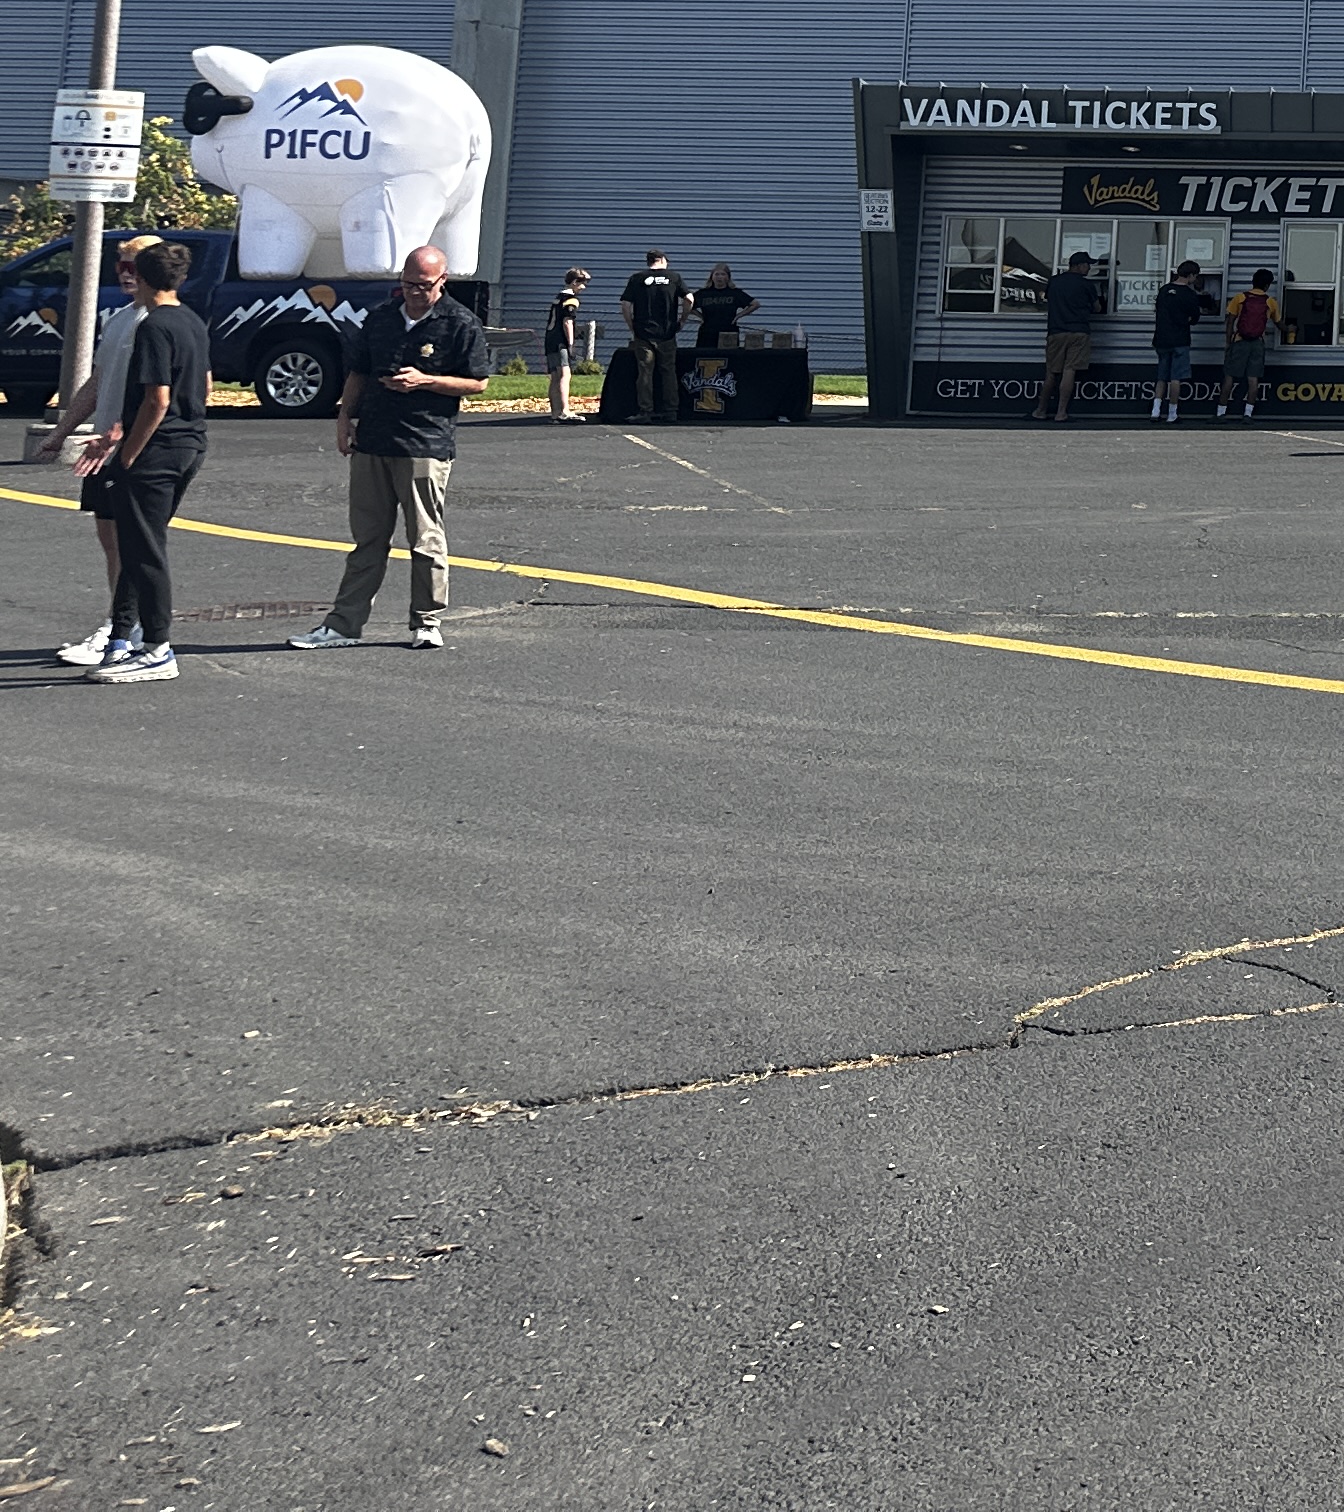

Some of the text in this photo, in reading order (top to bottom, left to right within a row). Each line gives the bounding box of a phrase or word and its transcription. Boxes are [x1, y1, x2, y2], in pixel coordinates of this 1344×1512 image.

[903, 98, 1218, 131] VANDAL TICKETS
[264, 128, 371, 161] P1FCU
[1083, 172, 1160, 212] Vandals
[1121, 280, 1163, 292] TICKET
[1123, 294, 1158, 306] SALES
[681, 371, 738, 398] Vandals
[936, 378, 985, 399] GET
[988, 379, 1055, 399] YOU
[1073, 380, 1156, 401] ICKETS
[1242, 382, 1272, 401] T
